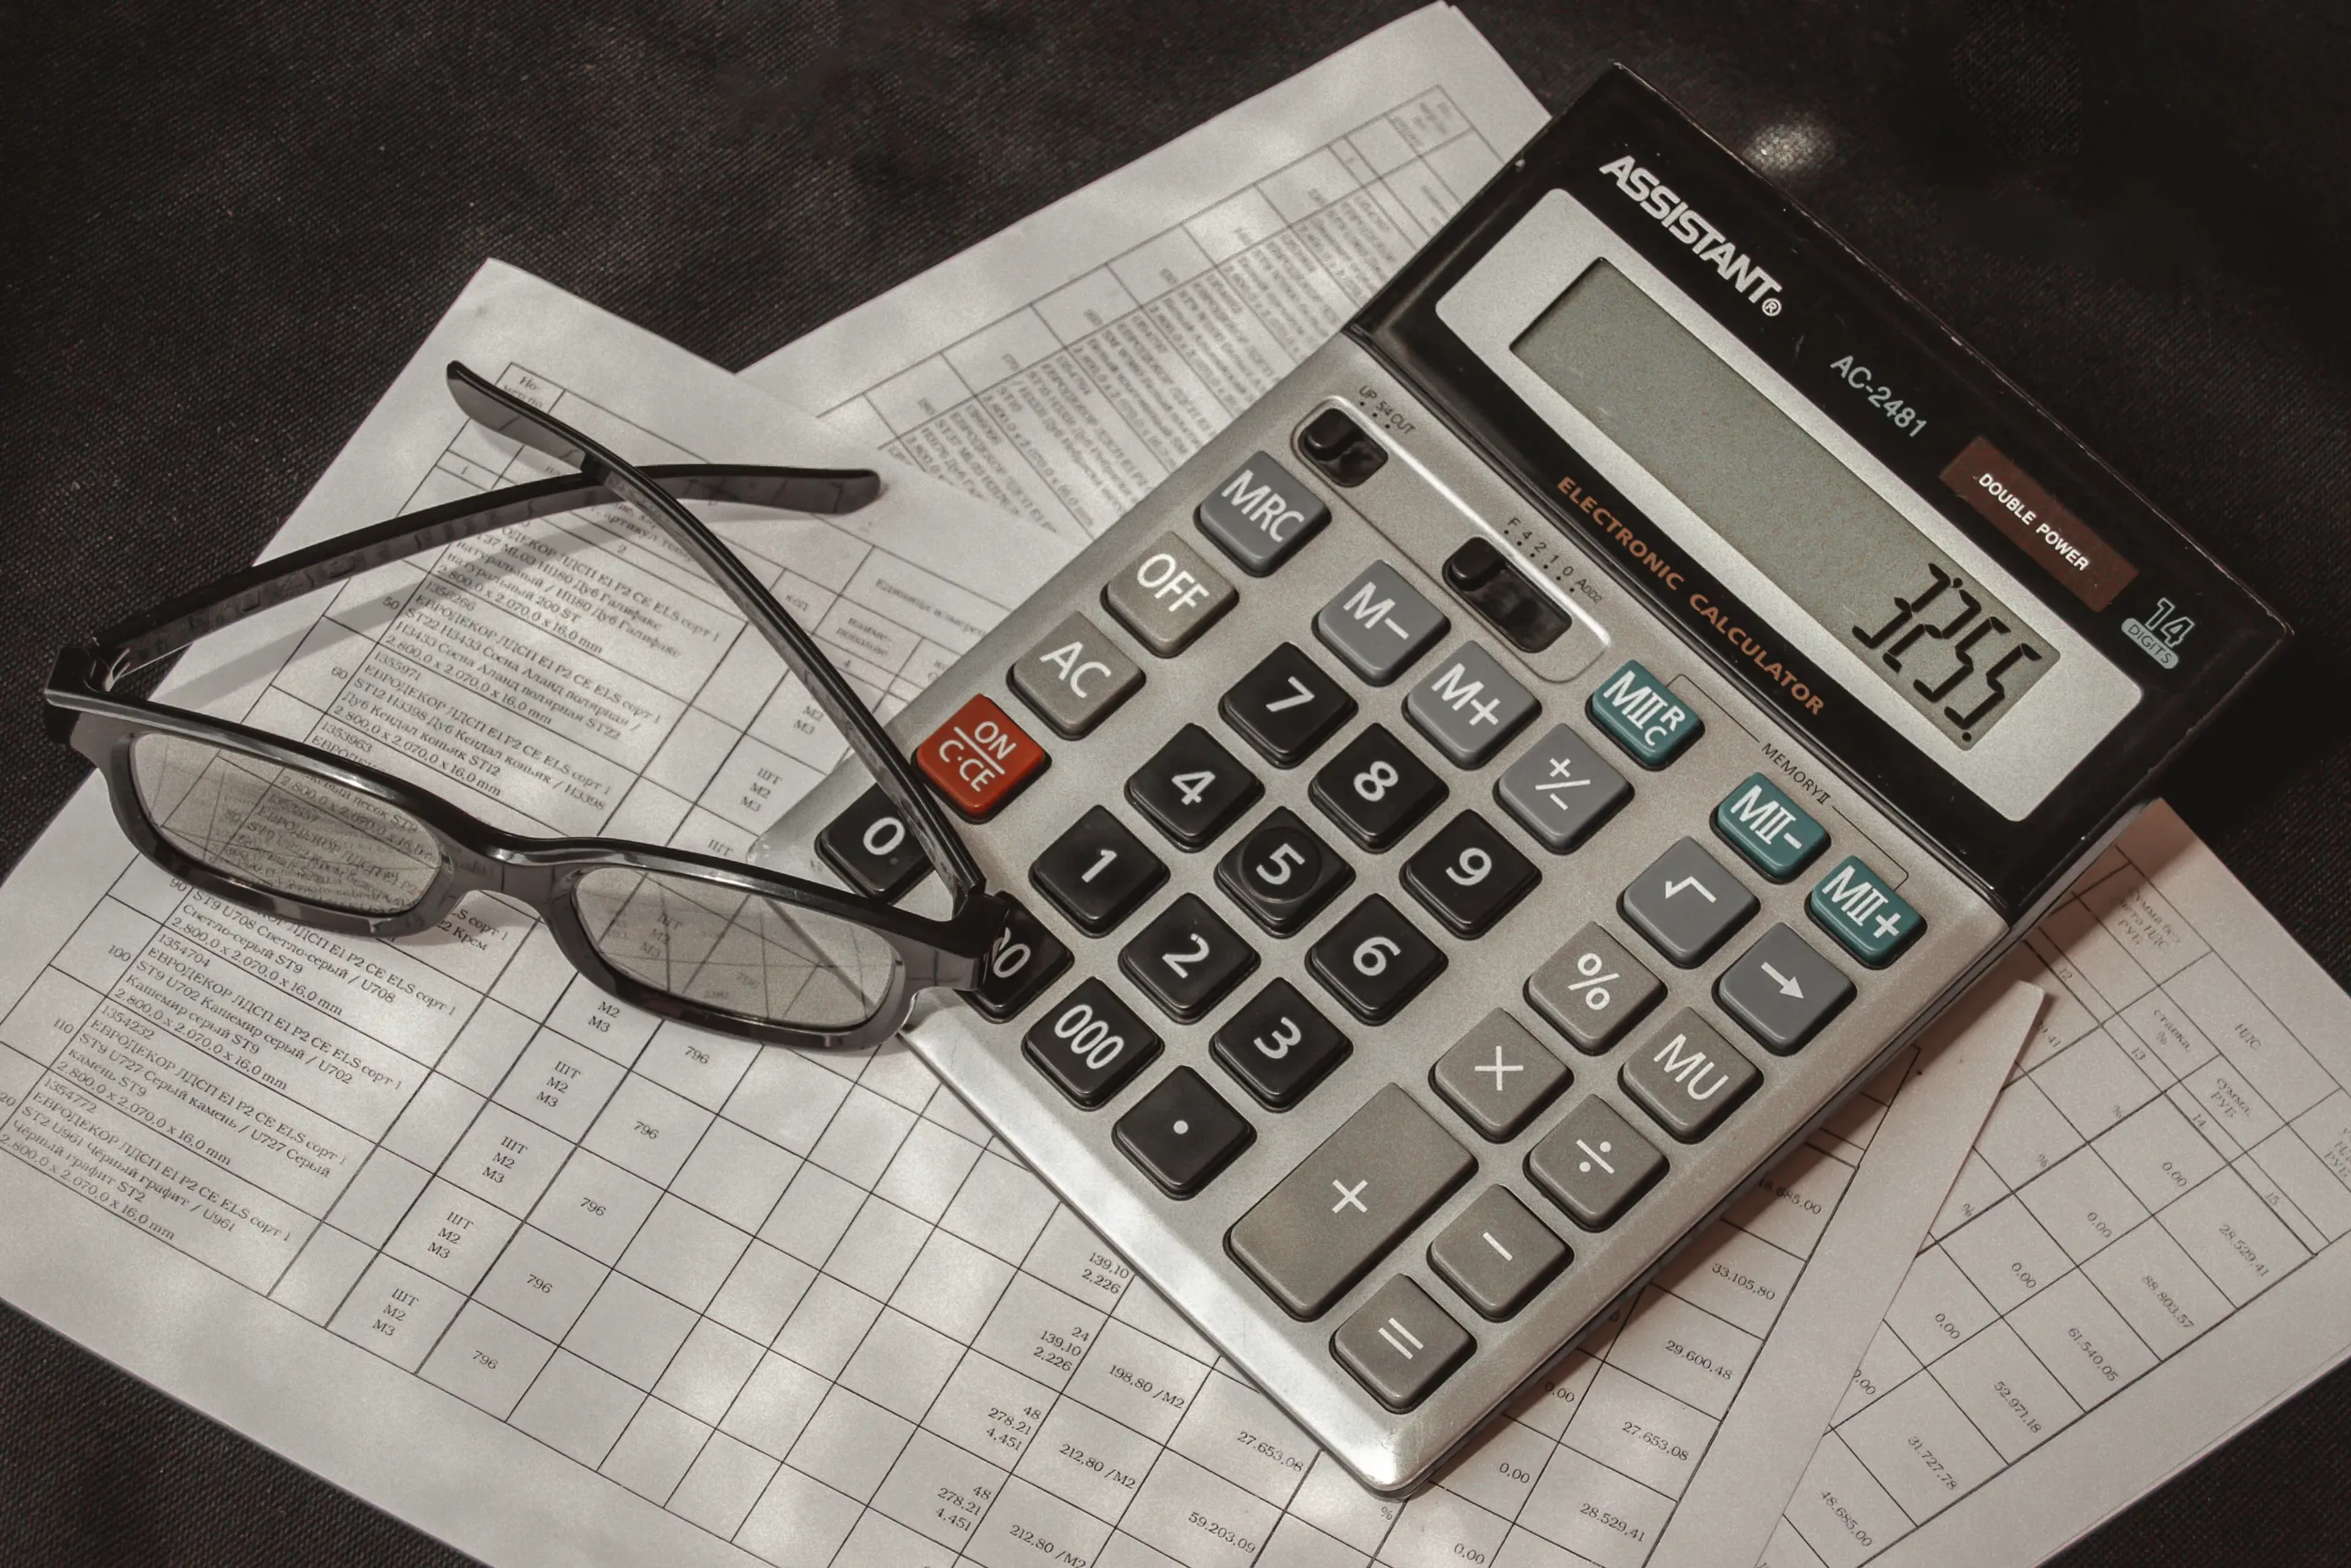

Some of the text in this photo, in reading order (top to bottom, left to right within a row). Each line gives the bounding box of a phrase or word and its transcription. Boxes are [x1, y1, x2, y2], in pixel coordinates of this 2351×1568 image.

[1830, 353, 1927, 438] AC-2481
[1221, 470, 1303, 543] MRC
[1978, 471, 2089, 572] DOUBLE POWER
[1521, 531, 1532, 539] 4
[1533, 541, 1547, 553] 2
[1137, 553, 1209, 613] OFF
[1557, 475, 1825, 716] ELECTRONIC CALCULATOR
[382, 596, 400, 610] 50
[2152, 597, 2195, 647] 14
[2128, 621, 2175, 667] DIGITS
[331, 666, 348, 680] 60
[1040, 641, 1111, 699] AC
[1265, 677, 1314, 712] 7
[1431, 663, 1500, 727] M+
[974, 721, 1016, 760] ON
[1171, 770, 1216, 805] 4
[1353, 760, 1398, 802] 8
[863, 816, 906, 855] 0
[1081, 849, 1117, 883] 1
[1255, 844, 1306, 885] 5
[1445, 847, 1492, 887] 9
[108, 944, 131, 962] 100
[159, 933, 210, 967] 1354704
[1162, 933, 1209, 978] 2
[1352, 936, 1401, 976] 6
[1568, 953, 1620, 1011] %
[53, 1018, 74, 1034] 110
[101, 1005, 155, 1040] 1354232
[126, 974, 260, 1054] Кашемир серый ST9
[136, 960, 165, 980] ST9
[165, 976, 200, 1001] U702
[200, 996, 263, 1037] Кашемир
[263, 1033, 305, 1059] серый
[318, 1059, 353, 1084] U702
[147, 947, 232, 997] ЕВРОДЕКОР
[231, 994, 274, 1022] ЛДСП
[331, 1048, 361, 1068] ELS
[684, 1046, 710, 1065] 796
[1053, 1003, 1125, 1070] 000
[1253, 1018, 1302, 1059] 3
[2131, 1046, 2147, 1061] 13
[261, 1072, 287, 1090] mm
[1653, 1033, 1729, 1101] MU
[250, 1128, 287, 1151] U727
[633, 1121, 659, 1140] 796
[2192, 1114, 2207, 1128] 14
[580, 1198, 606, 1217] 796
[526, 1274, 552, 1294] 796
[1071, 1326, 1089, 1342] 24
[472, 1351, 498, 1370] 796
[1022, 1405, 1042, 1420] 48
[972, 1485, 992, 1501] 48
